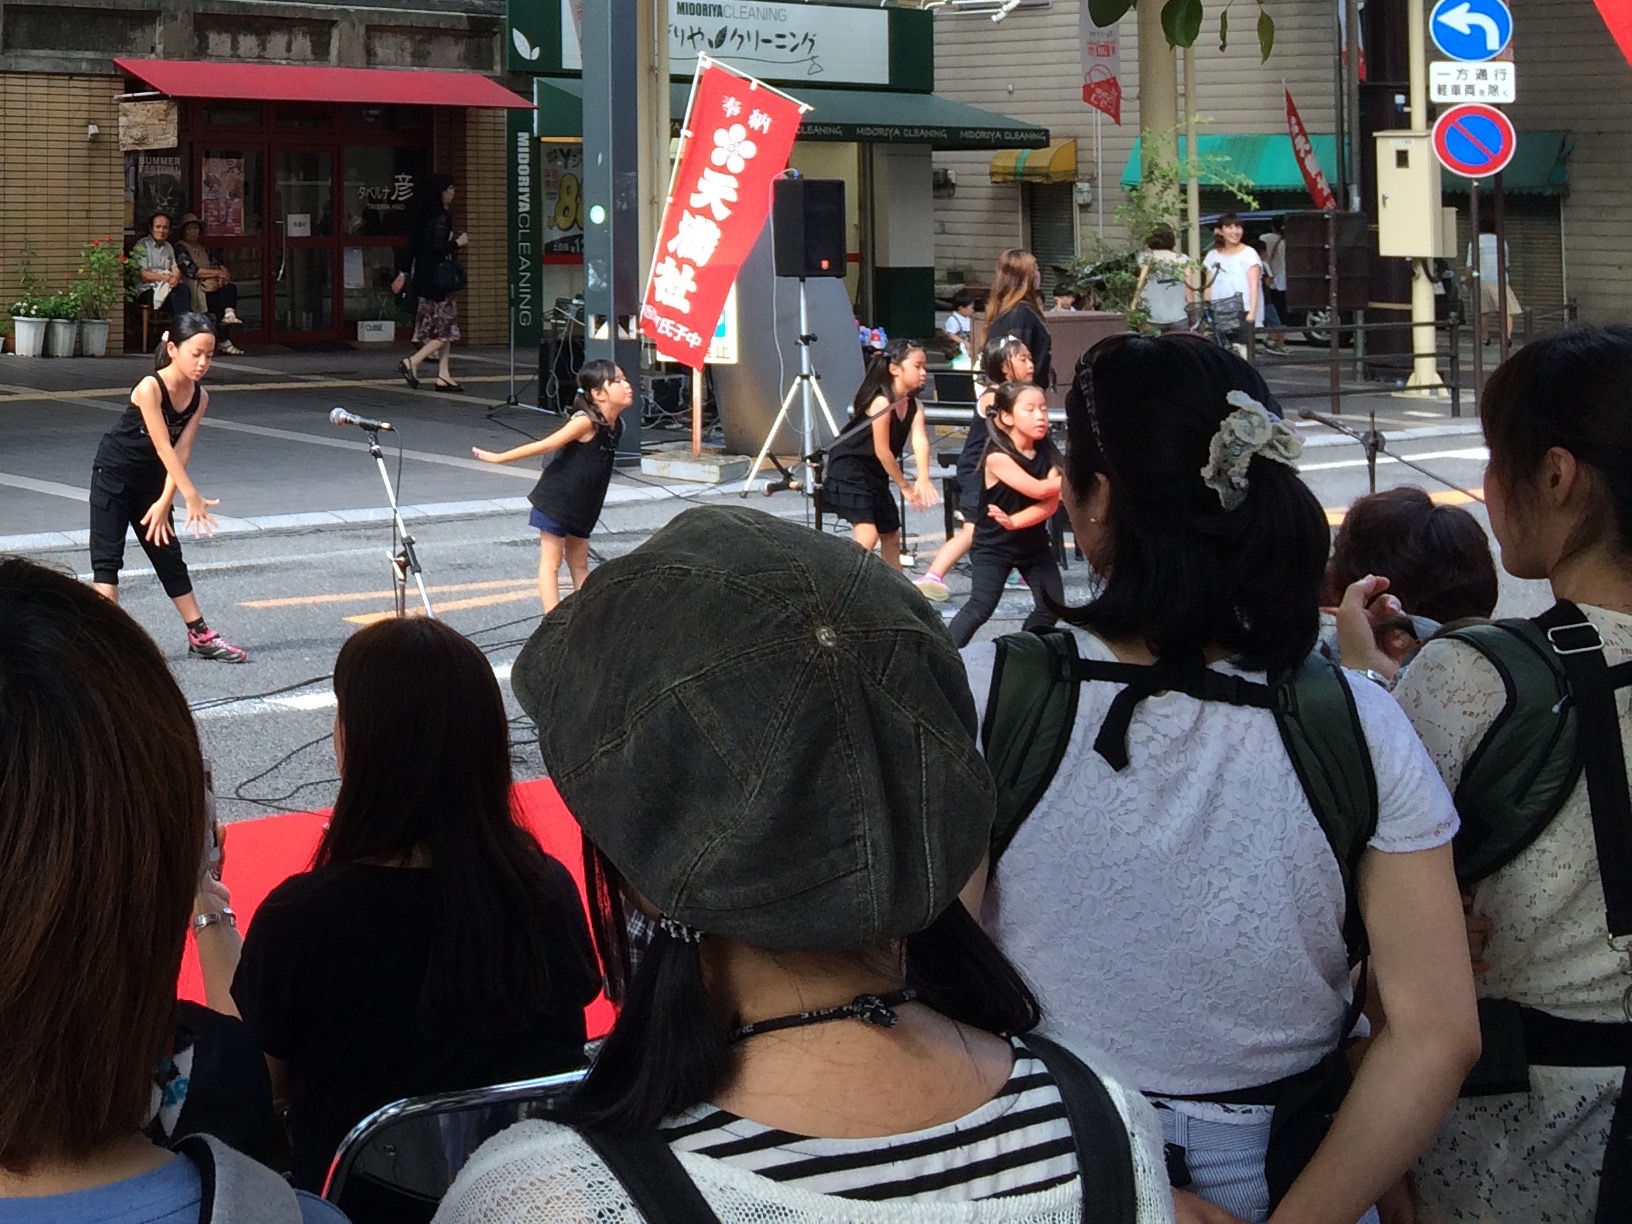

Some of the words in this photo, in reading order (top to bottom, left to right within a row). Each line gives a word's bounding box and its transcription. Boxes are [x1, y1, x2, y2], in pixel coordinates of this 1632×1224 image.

[730, 26, 818, 55] クリーニング
[1436, 68, 1508, 81] 一方通行
[1436, 84, 1509, 97] 軽車両を除く
[855, 126, 900, 140] MIDORIYA
[903, 128, 948, 140] CLEANING
[959, 130, 1003, 144] MIDORIYA
[1004, 131, 1047, 142] CLEANING
[138, 156, 181, 165] SUMMER
[653, 166, 740, 314] 天満社
